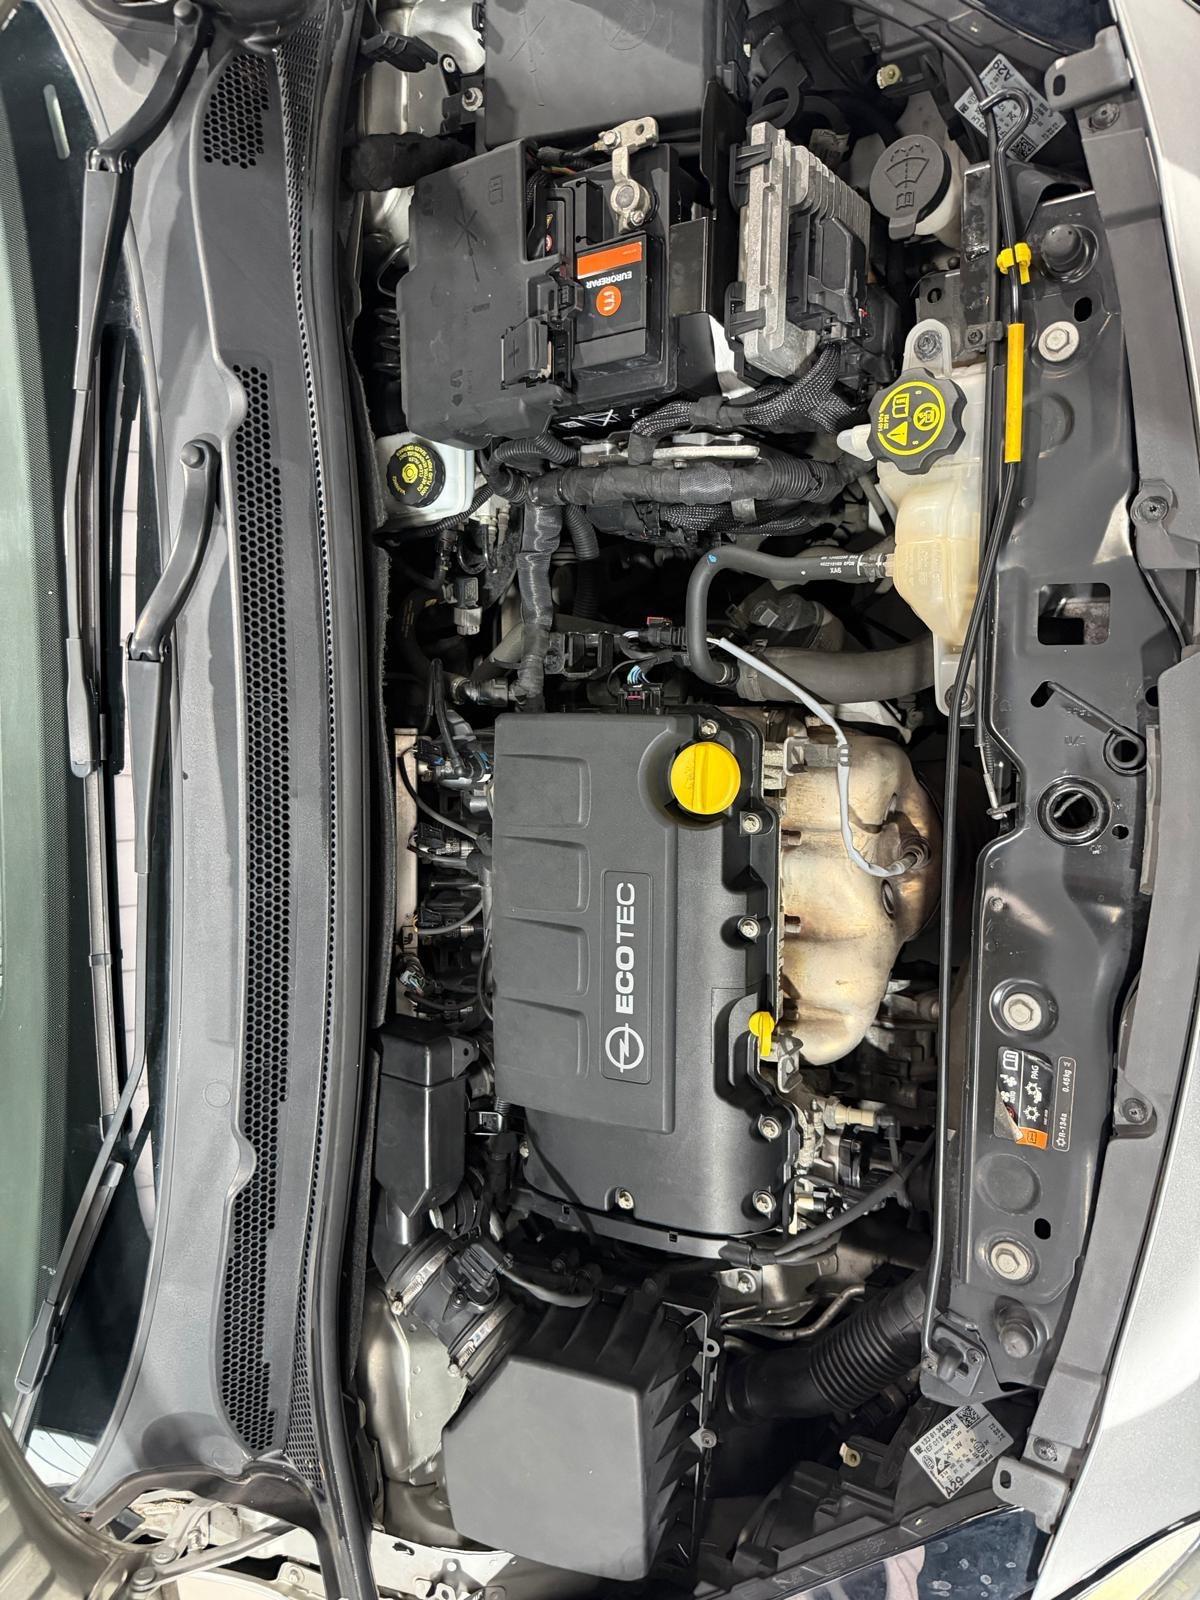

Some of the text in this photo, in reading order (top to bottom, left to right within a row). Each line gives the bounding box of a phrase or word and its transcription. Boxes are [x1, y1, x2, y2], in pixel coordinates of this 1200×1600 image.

[992, 59, 1013, 81] A29
[585, 270, 632, 288] EUROREPAR
[616, 882, 635, 1014] ECOTEC
[1031, 1065, 1039, 1079] PAG
[944, 1416, 954, 1426] RH
[944, 1476, 965, 1497] A29
